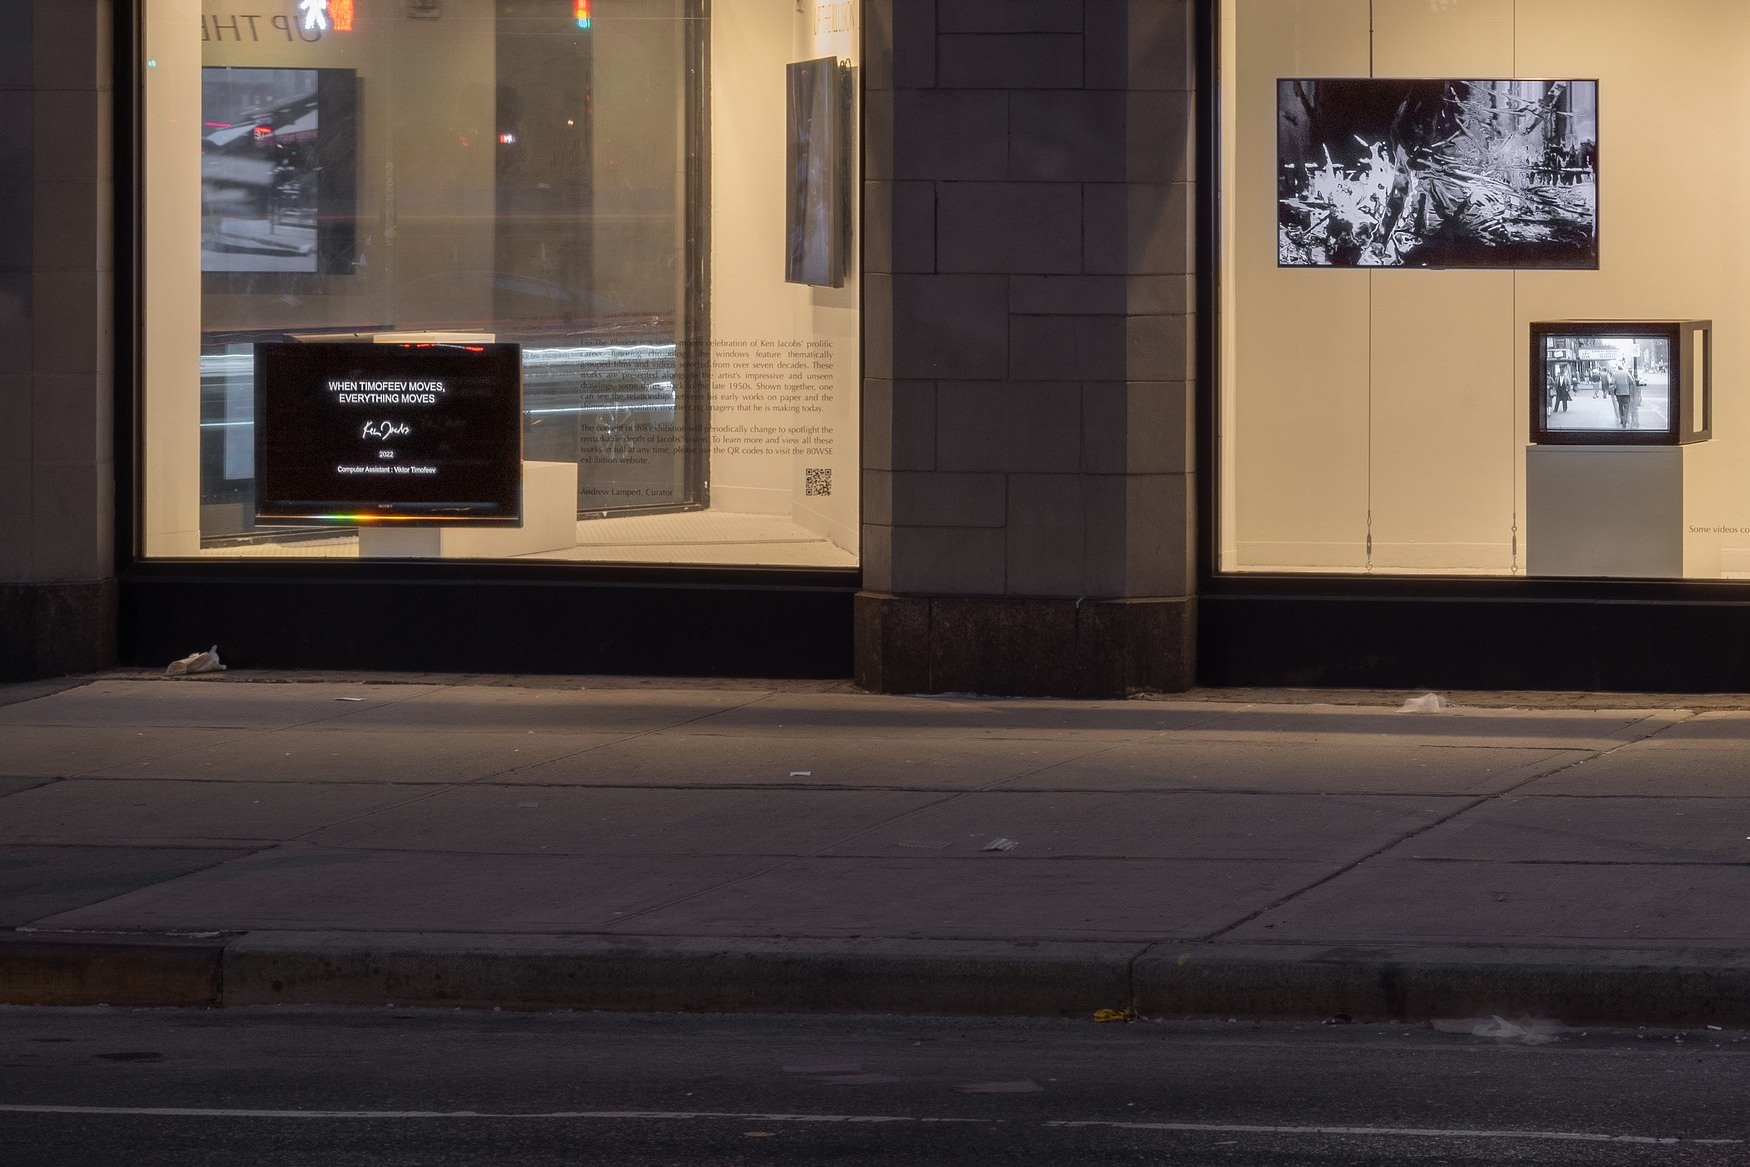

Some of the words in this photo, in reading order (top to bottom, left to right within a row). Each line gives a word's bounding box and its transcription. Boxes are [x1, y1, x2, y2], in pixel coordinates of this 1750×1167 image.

[806, 340, 833, 349] prolific
[716, 350, 749, 358] windows
[756, 350, 781, 358] feature
[787, 350, 834, 360] thematically
[776, 361, 809, 369] decades.
[813, 361, 834, 369] These
[745, 372, 784, 381] impressive
[329, 382, 357, 391] WHEN
[359, 382, 407, 391] TIMOFEEV
[408, 382, 446, 393] MOVES,
[729, 382, 753, 390] 1950s.
[784, 383, 816, 392] together,
[339, 393, 399, 403] EVERYTHING
[401, 394, 435, 403] MOVES
[721, 393, 740, 402] early
[742, 393, 764, 401] works
[780, 395, 801, 403] paper
[804, 393, 819, 401] and
[821, 393, 834, 401] the
[750, 425, 776, 435] change
[787, 426, 820, 435] spotlight
[822, 426, 834, 434] the
[337, 466, 365, 474] Computer
[580, 488, 610, 496] Andrew
[612, 489, 642, 497] Lampert,
[1689, 525, 1711, 533] Some
[1713, 525, 1738, 533] videos
